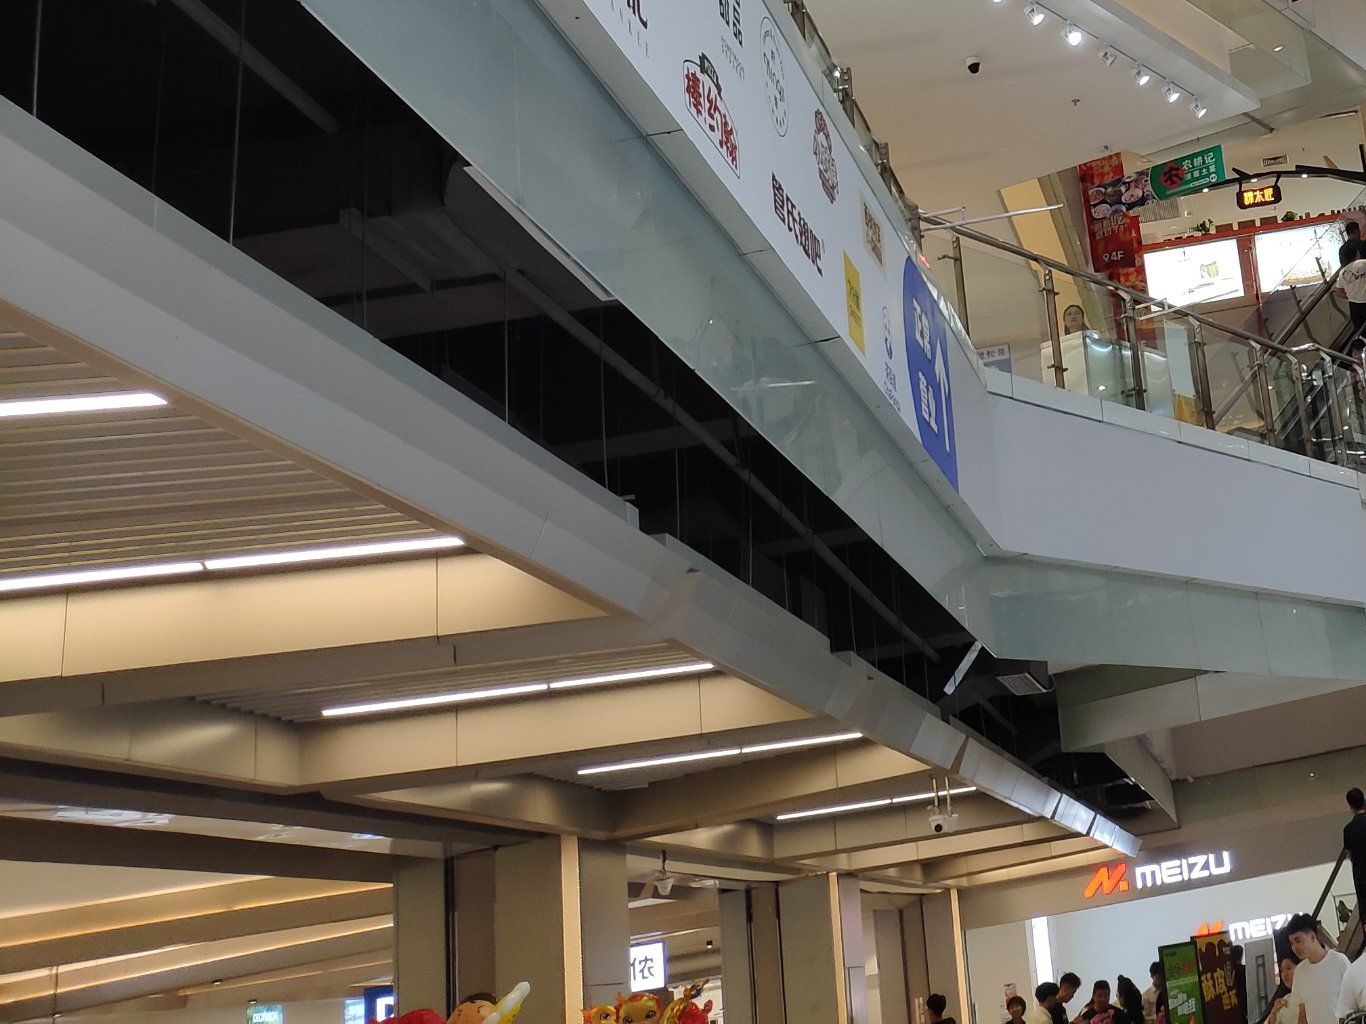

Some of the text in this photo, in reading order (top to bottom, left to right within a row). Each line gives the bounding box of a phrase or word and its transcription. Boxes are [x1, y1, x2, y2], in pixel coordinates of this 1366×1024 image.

[1110, 251, 1125, 262] 4F
[1135, 849, 1232, 889] MEIZU
[1228, 911, 1303, 942] MEIZ
